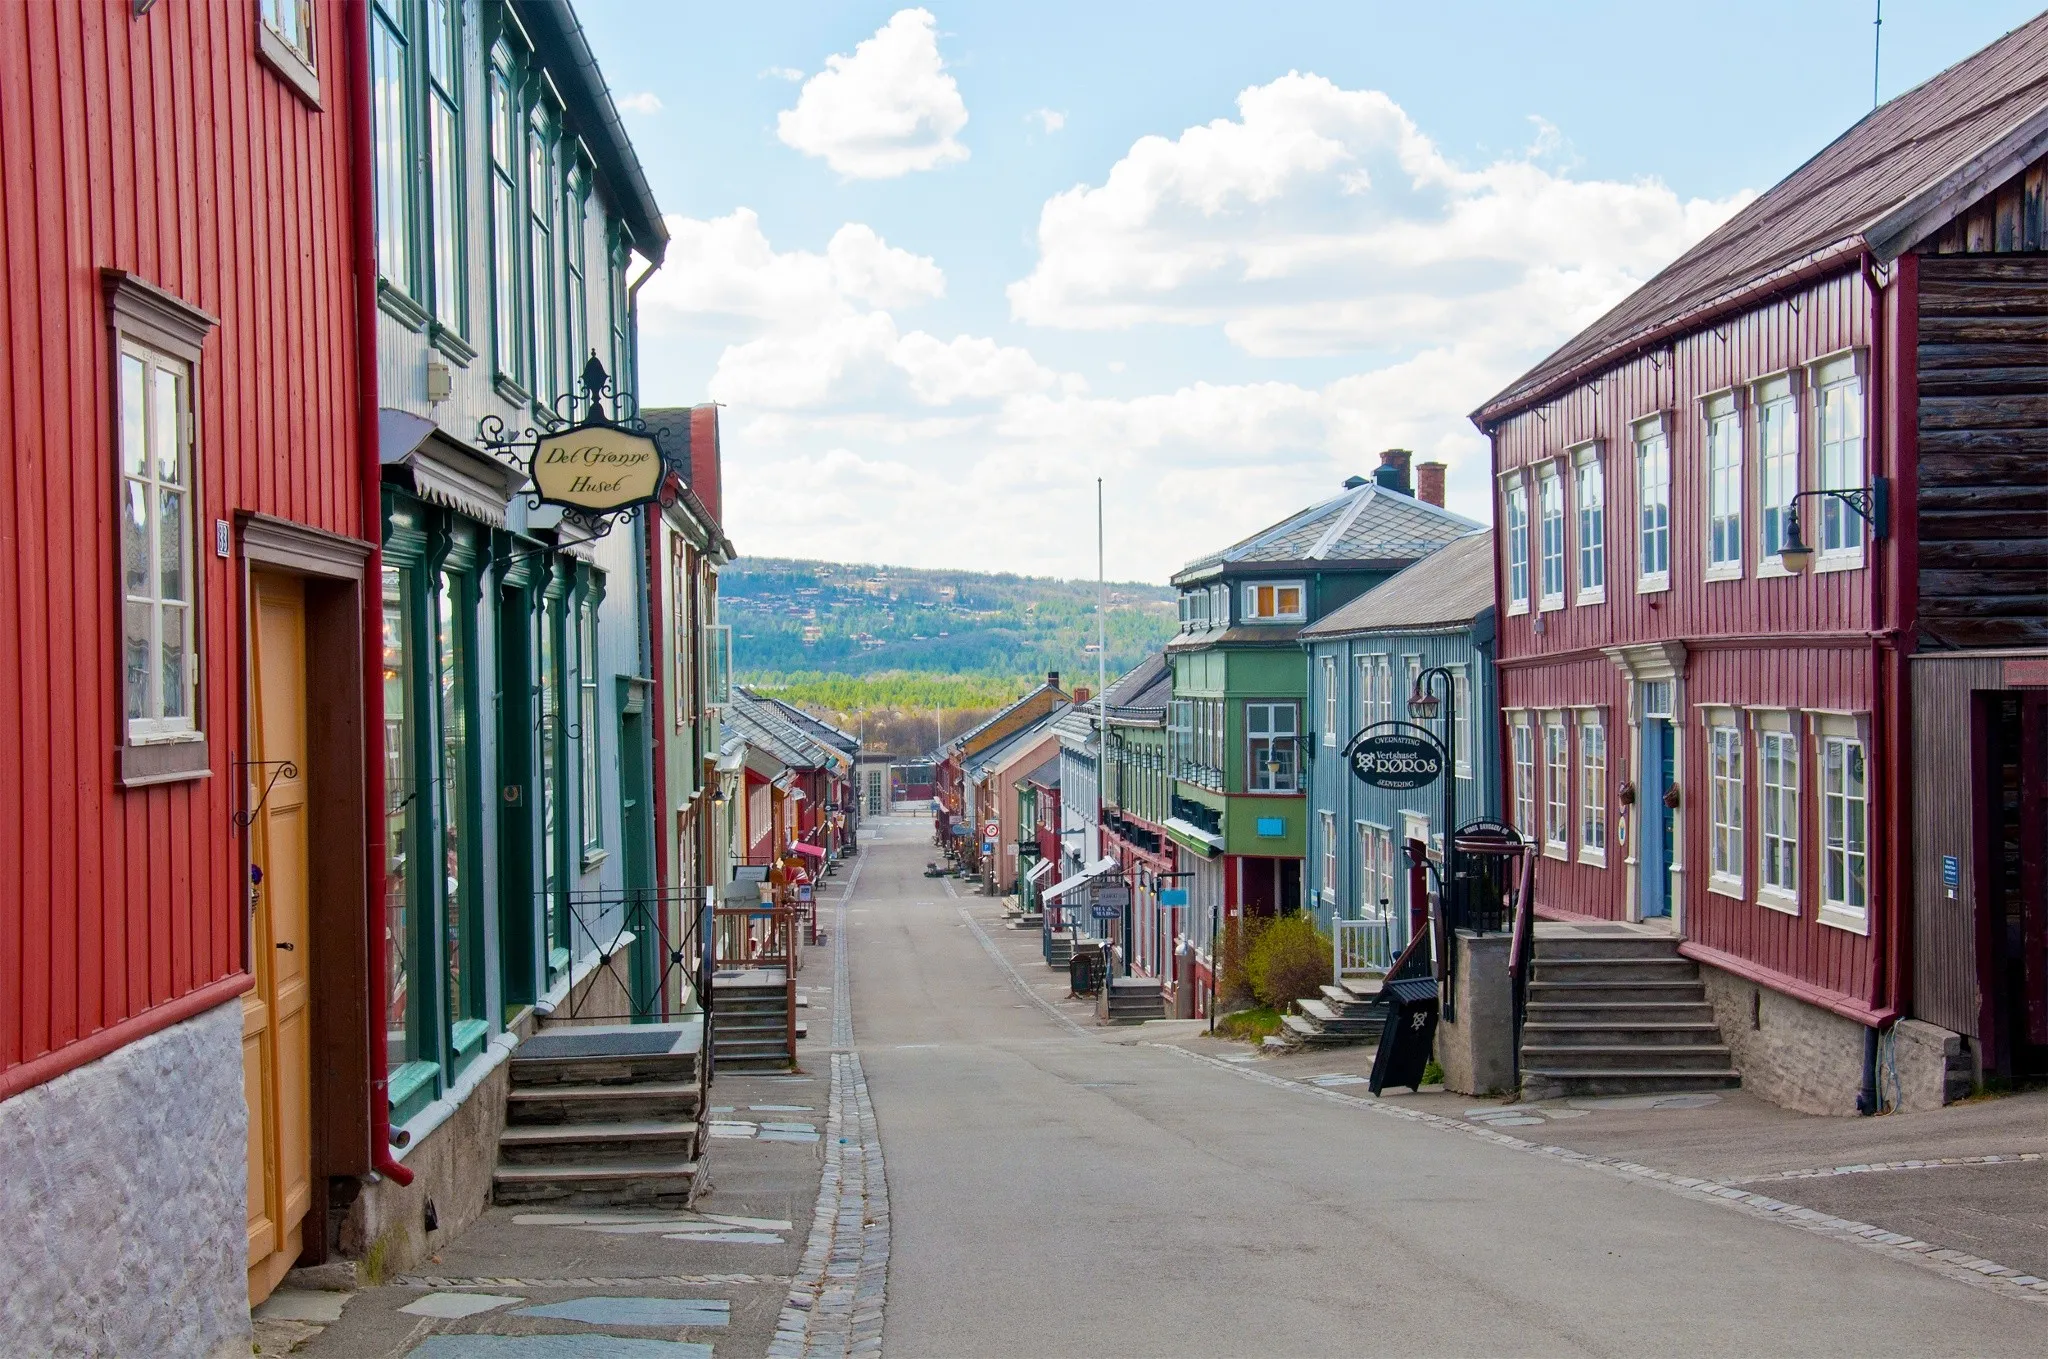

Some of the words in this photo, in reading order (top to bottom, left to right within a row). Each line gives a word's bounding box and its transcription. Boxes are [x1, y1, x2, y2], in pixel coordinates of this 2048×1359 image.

[544, 447, 589, 464] Det
[583, 446, 650, 467] Grønne
[568, 475, 633, 493] Huset
[1374, 736, 1420, 747] OVERNATTING
[1376, 751, 1418, 760] Vertshuset
[1376, 759, 1438, 773] RØROS
[1376, 780, 1414, 788] SERVERING
